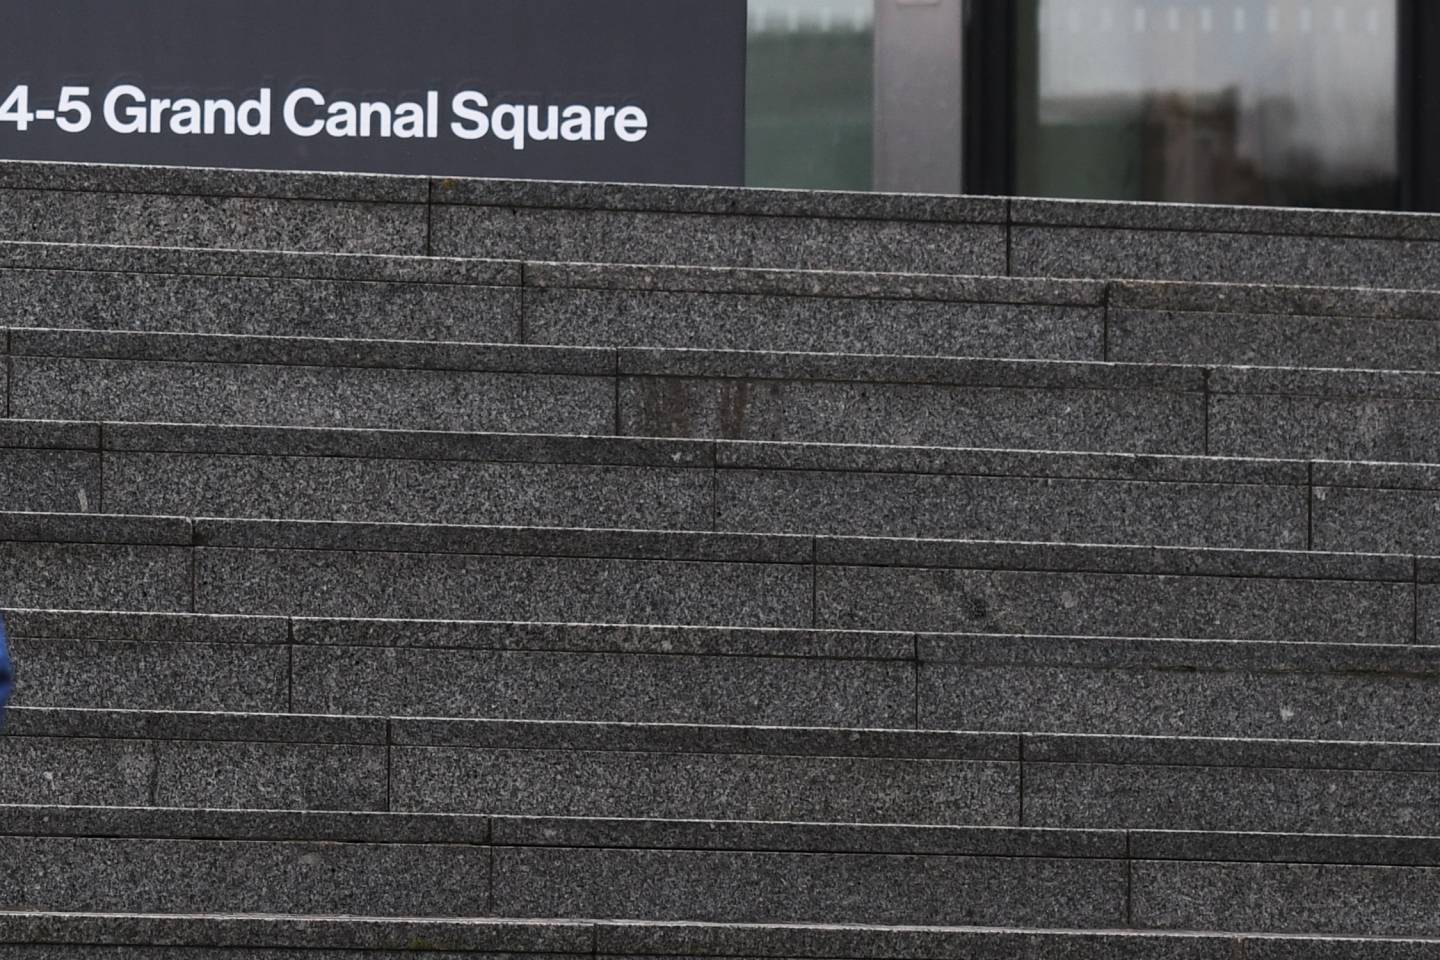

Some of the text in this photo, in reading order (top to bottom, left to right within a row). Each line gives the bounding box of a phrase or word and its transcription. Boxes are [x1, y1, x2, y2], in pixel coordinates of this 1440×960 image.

[103, 84, 271, 136] Grand
[283, 87, 439, 138] Canal
[450, 90, 648, 150] Square
